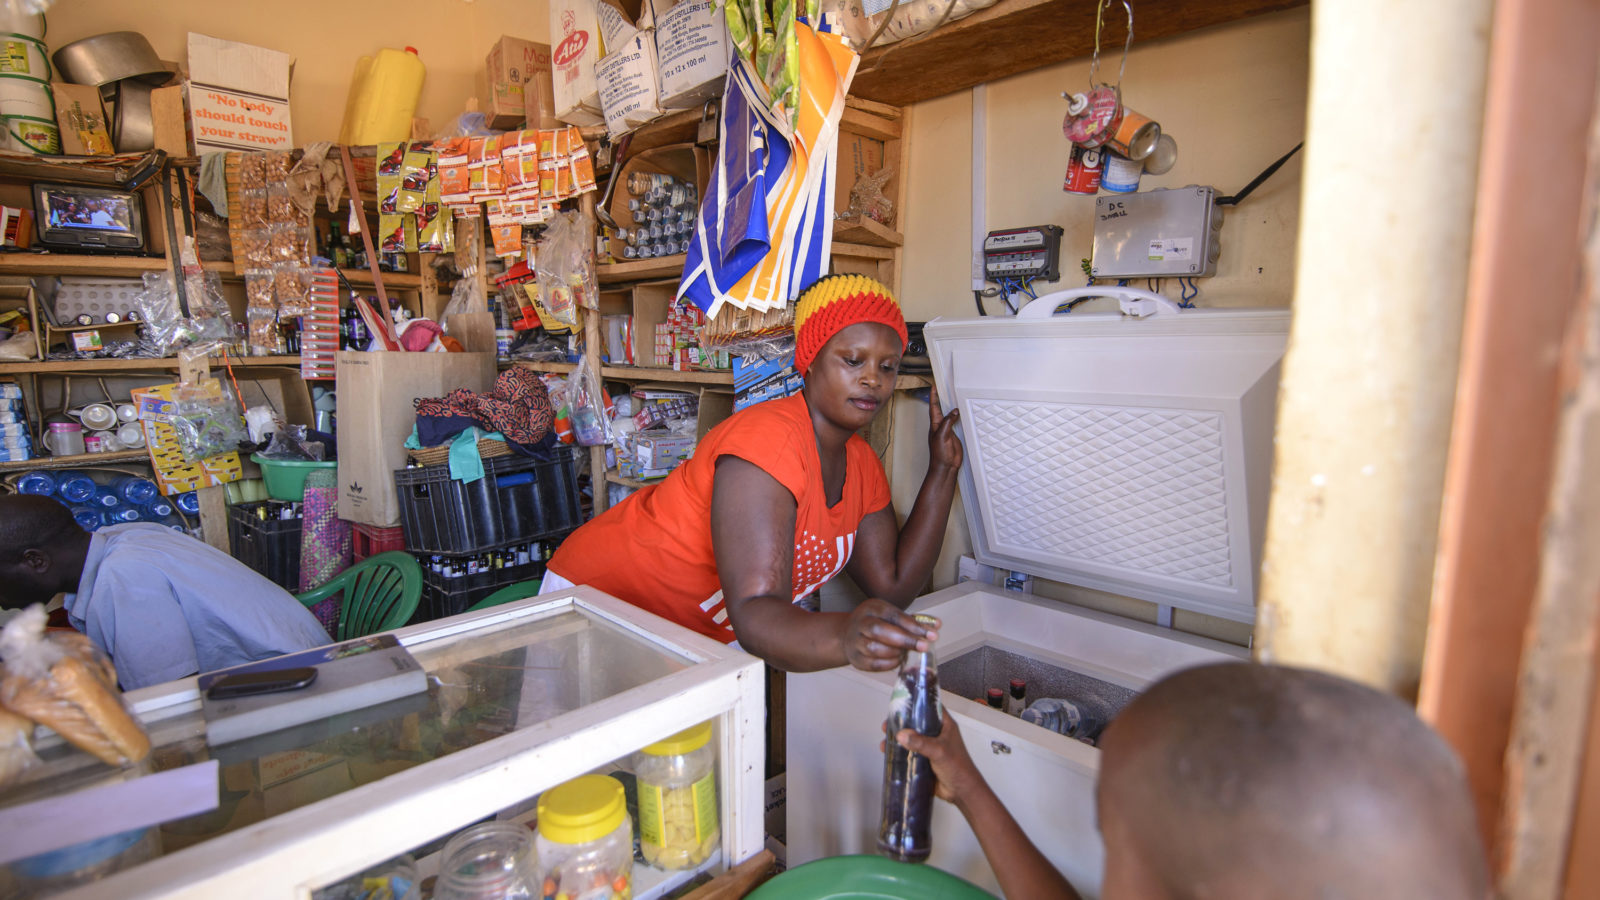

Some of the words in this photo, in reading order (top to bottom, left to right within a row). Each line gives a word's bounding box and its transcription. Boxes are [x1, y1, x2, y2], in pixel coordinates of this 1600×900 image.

[665, 70, 671, 79] 10
[675, 65, 681, 73] 12
[686, 58, 697, 68] 100
[698, 54, 706, 63] ml
[240, 99, 275, 116] body
[195, 108, 246, 125] should
[249, 116, 288, 132] touch
[199, 125, 235, 139] your
